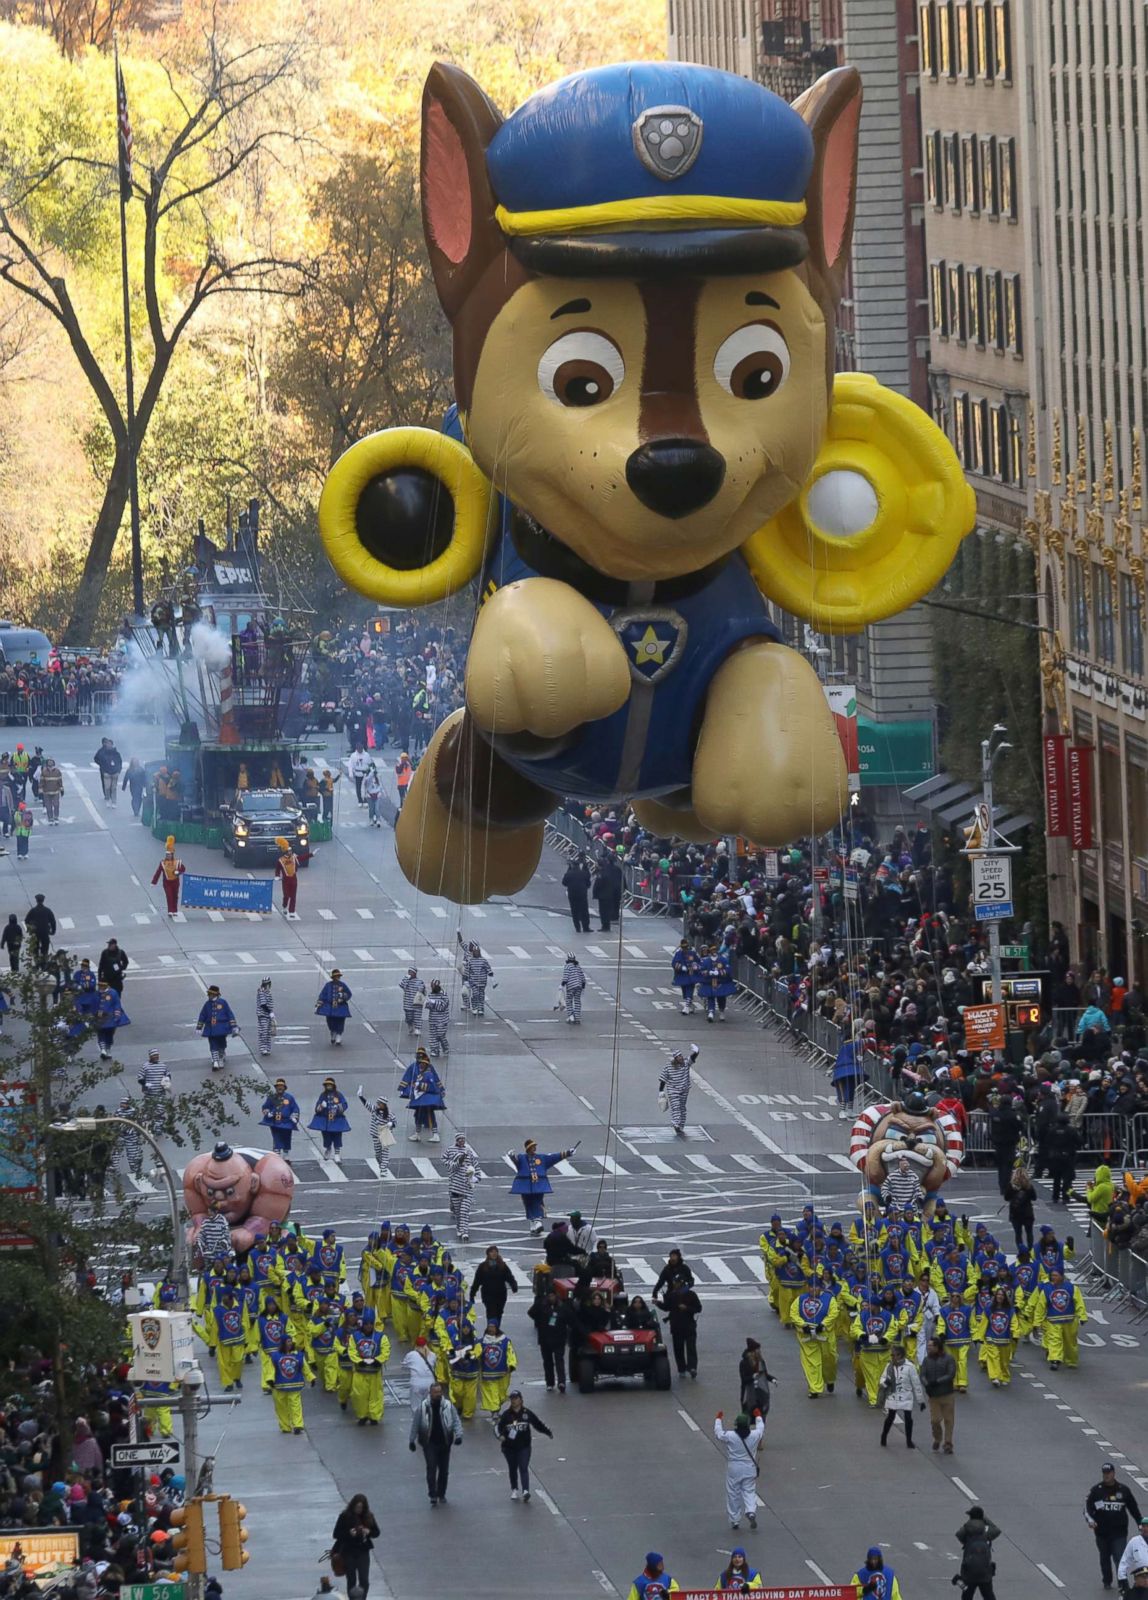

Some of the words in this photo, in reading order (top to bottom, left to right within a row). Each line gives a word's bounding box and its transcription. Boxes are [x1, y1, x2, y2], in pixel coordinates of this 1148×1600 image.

[1047, 739, 1057, 787] QUALITY
[1070, 751, 1081, 799] QUALITY
[1049, 789, 1059, 832] ITALIAN
[1072, 801, 1083, 846] ITALIAN
[220, 889, 250, 899] GRAHAM
[978, 882, 1006, 899] 25
[967, 1008, 999, 1020] MACY'S
[737, 1094, 838, 1106] ONLY
[118, 1449, 138, 1460] ONE
[149, 1448, 171, 1459] WAY
[152, 1586, 170, 1600] 56
[788, 1590, 805, 1598] DAY
[808, 1589, 842, 1598] PARADE
